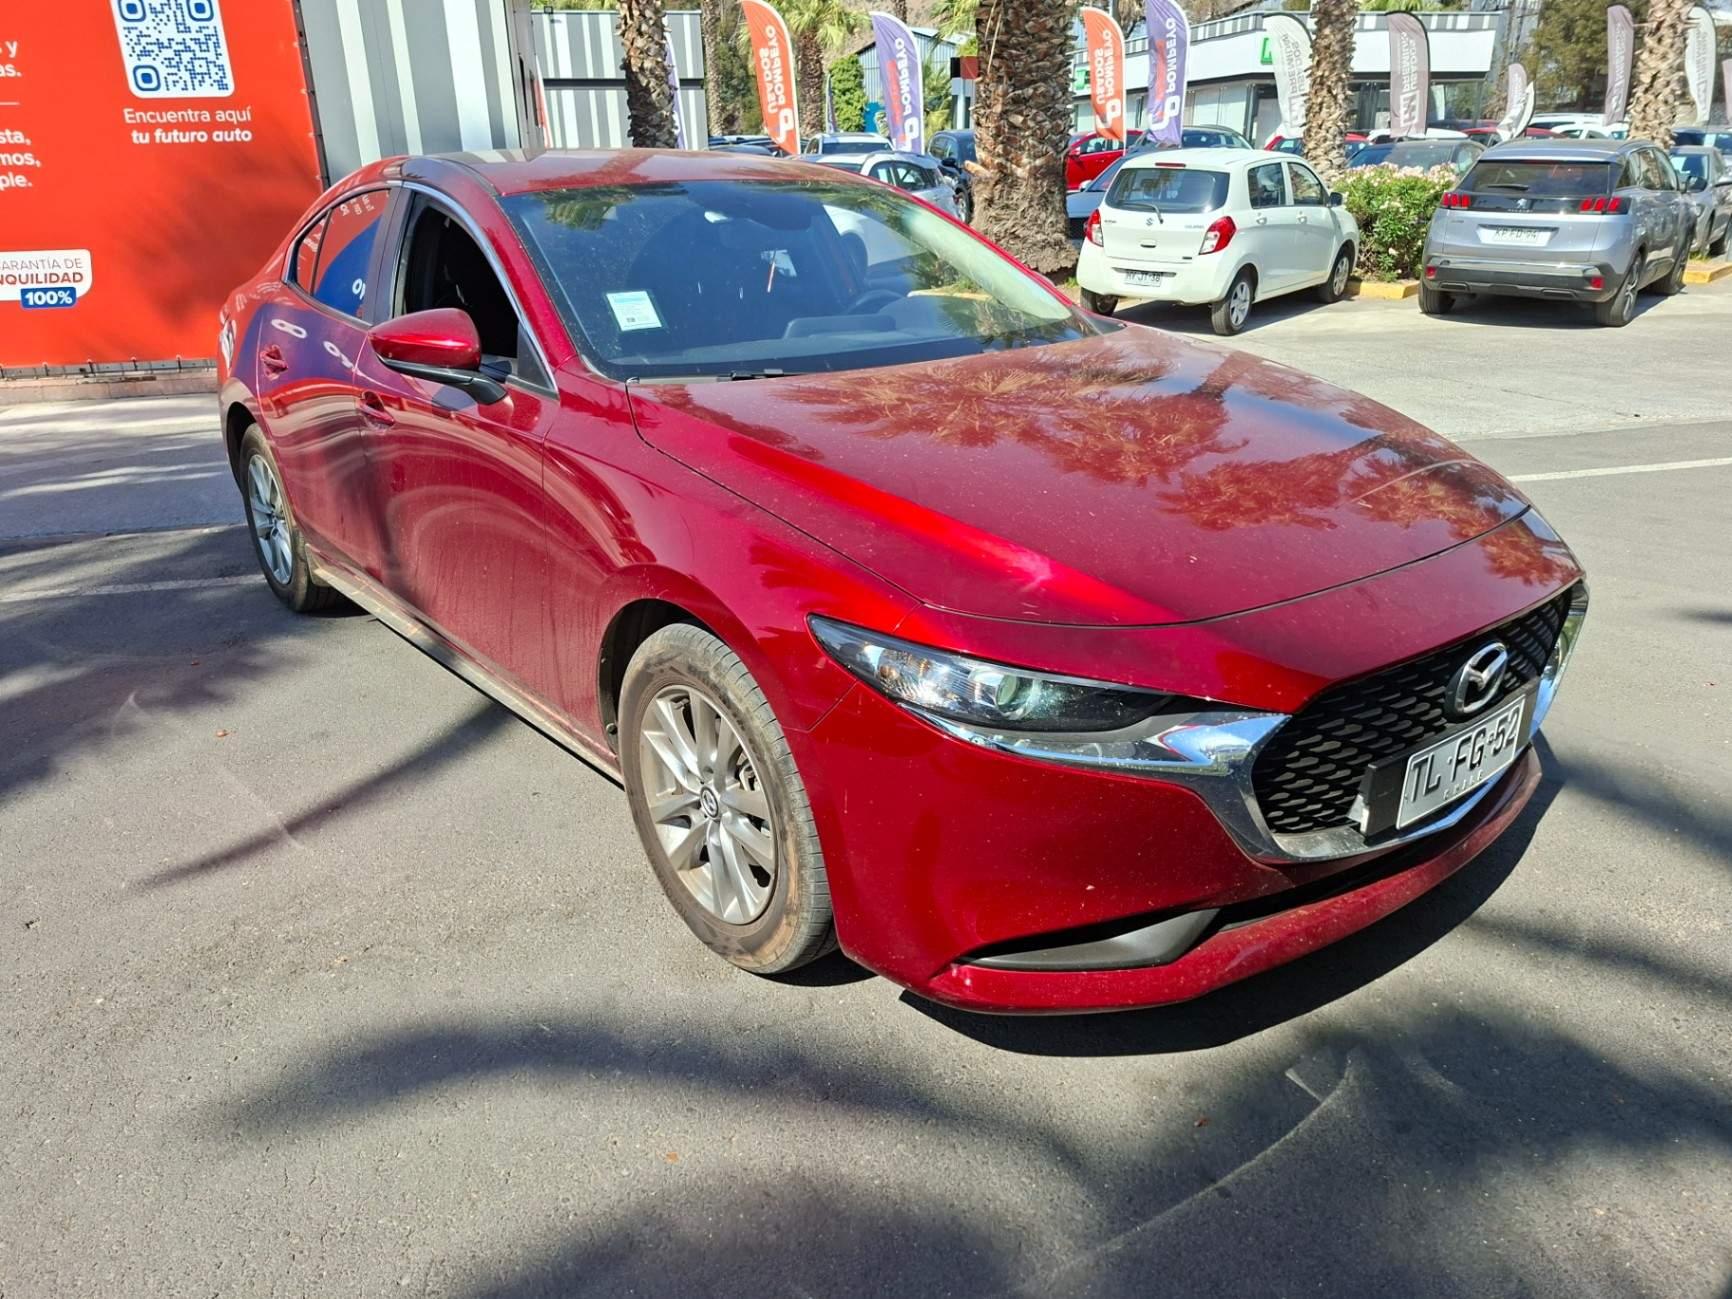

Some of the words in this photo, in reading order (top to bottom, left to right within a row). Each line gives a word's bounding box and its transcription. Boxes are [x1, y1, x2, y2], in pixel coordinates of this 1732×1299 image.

[5, 40, 18, 58] y
[123, 107, 210, 124] Encuentra
[215, 106, 252, 125] aquí
[131, 129, 150, 144] tu
[154, 128, 208, 143] futuro
[212, 128, 253, 142] auto
[0, 256, 62, 271] ARANTÍA
[64, 258, 83, 269] DE
[25, 290, 73, 306] 100%
